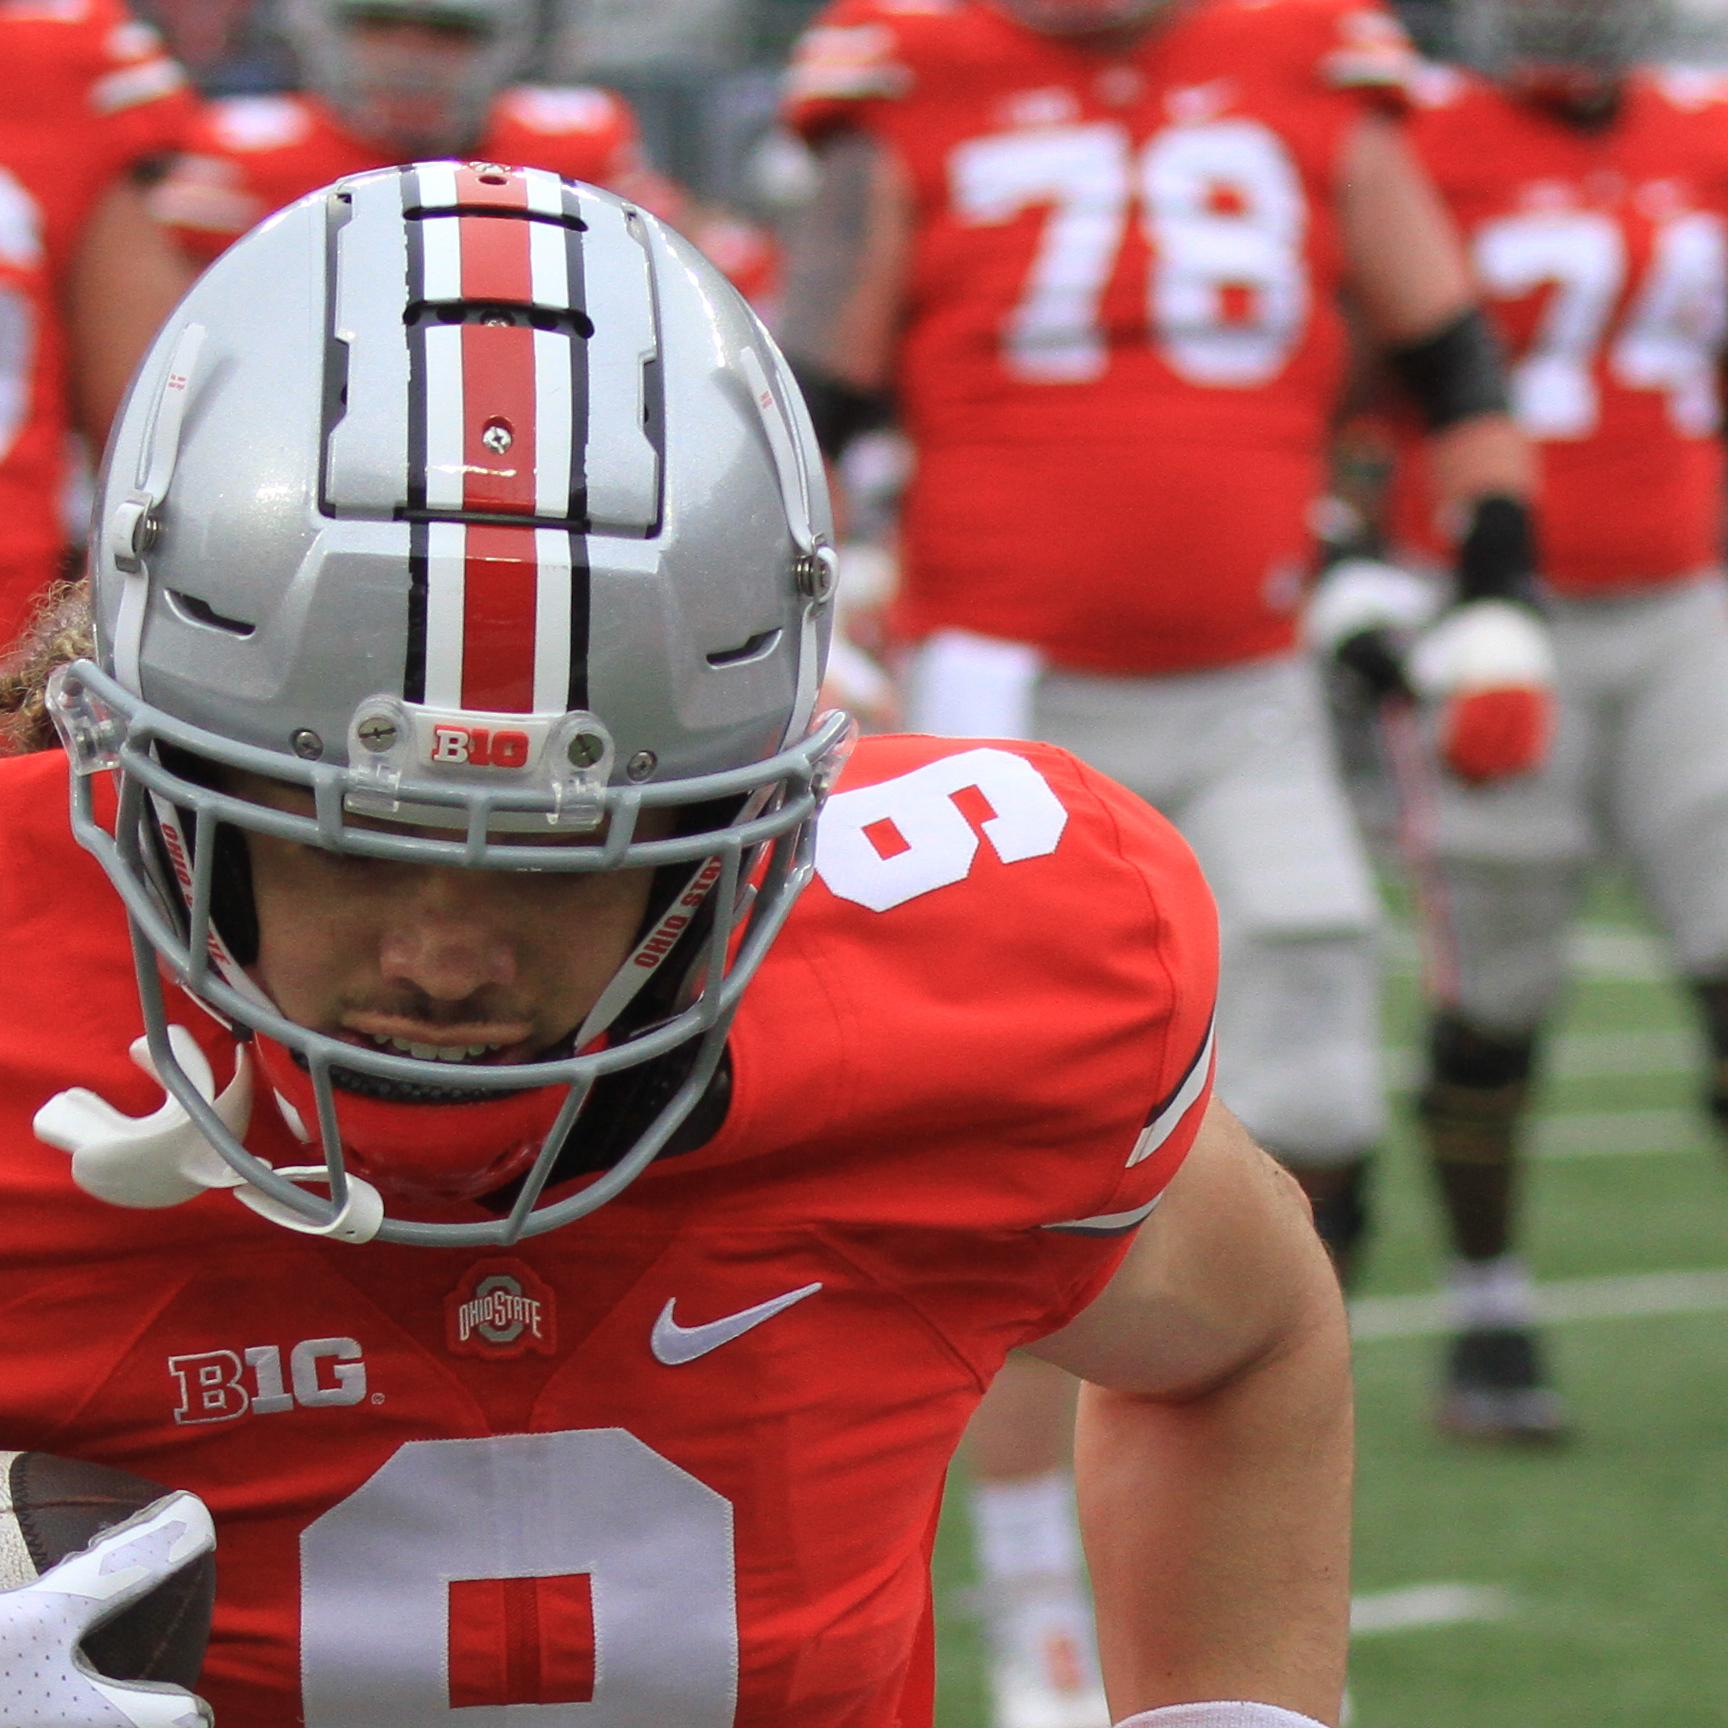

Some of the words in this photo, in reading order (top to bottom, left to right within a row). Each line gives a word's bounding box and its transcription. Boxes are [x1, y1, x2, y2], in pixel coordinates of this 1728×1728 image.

[944, 120, 1314, 388] 78
[813, 747, 1069, 913] 9
[633, 914, 690, 970] OHIO
